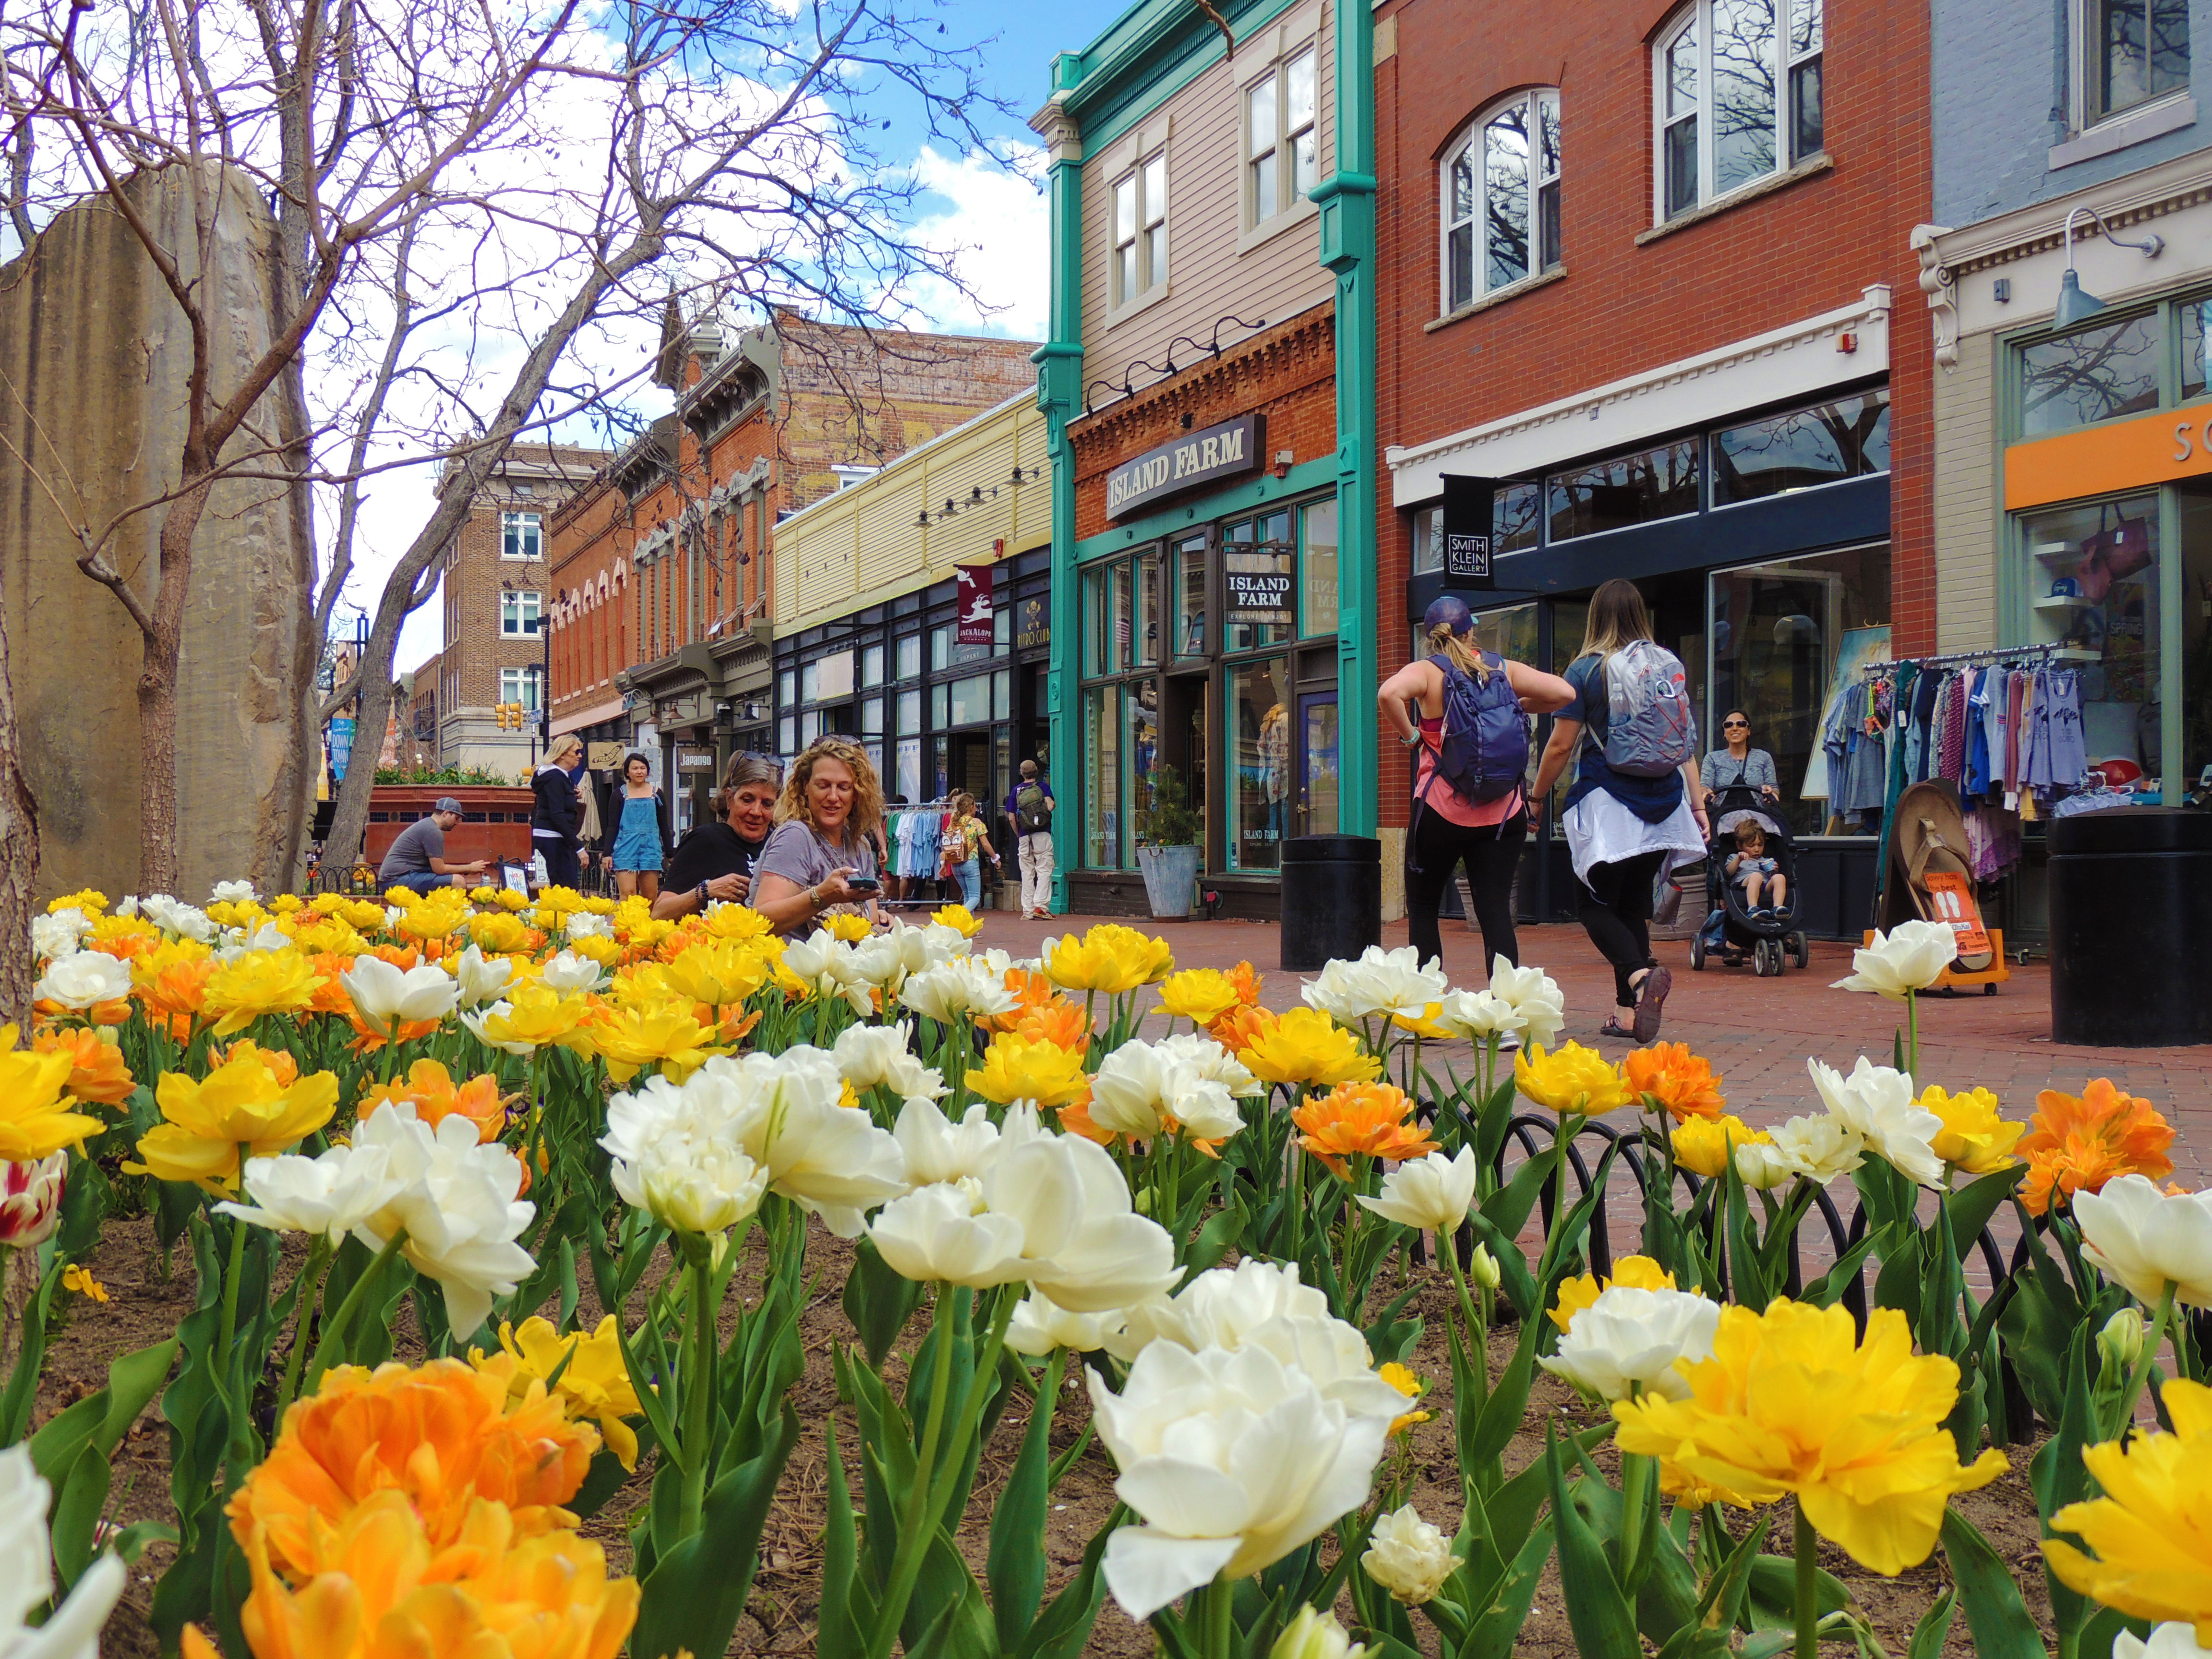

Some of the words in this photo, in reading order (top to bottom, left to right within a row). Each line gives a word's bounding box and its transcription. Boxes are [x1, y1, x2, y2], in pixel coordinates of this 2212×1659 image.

[1109, 455, 1169, 509] ISLAND
[1174, 427, 1244, 480] FARM
[1452, 538, 1484, 552] SMITH
[1453, 551, 1484, 564] KLEIN
[1452, 563, 1485, 572] GALLERY
[1229, 577, 1290, 591] ISLAND
[1238, 592, 1282, 606] FARM
[960, 628, 991, 637] JACKALOPE
[2110, 622, 2142, 635] SPRING
[1018, 631, 1035, 648] NITRO
[1036, 628, 1050, 643] CLUB
[332, 734, 349, 748] DOWN
[333, 748, 349, 763] TOWN
[680, 753, 711, 767] Japango
[1244, 830, 1262, 839] ISLAND
[1264, 830, 1279, 839] FARM
